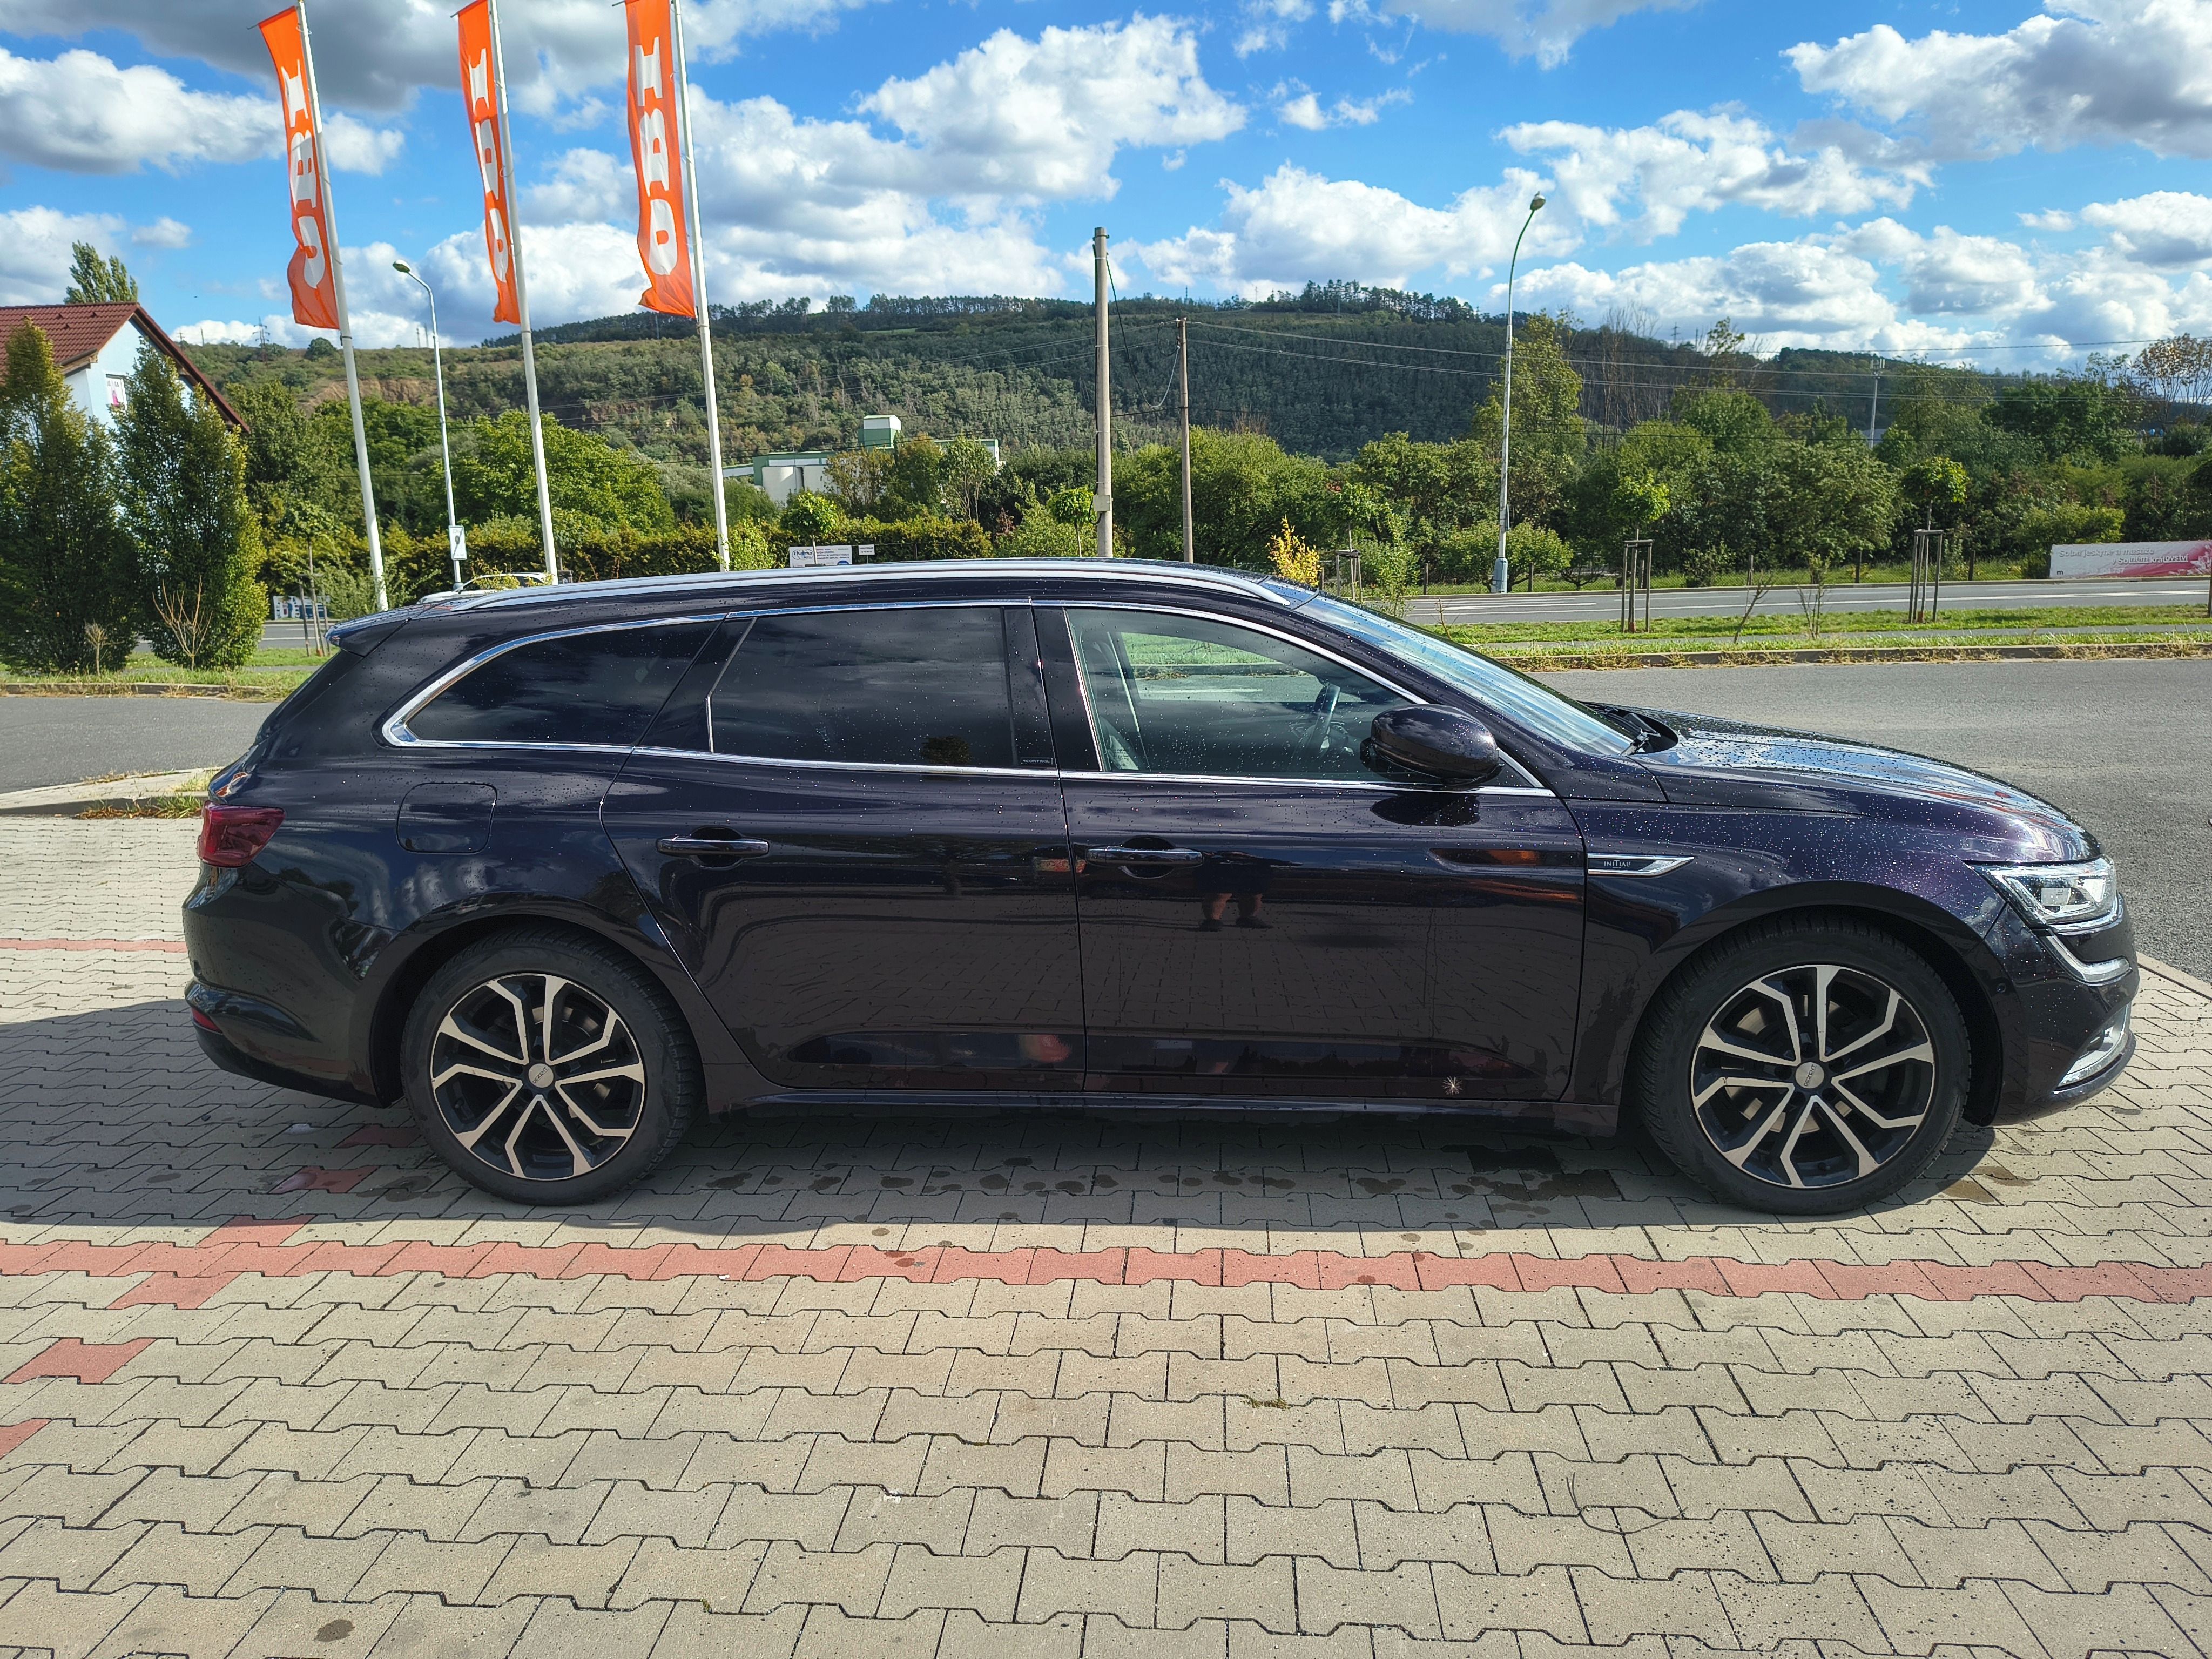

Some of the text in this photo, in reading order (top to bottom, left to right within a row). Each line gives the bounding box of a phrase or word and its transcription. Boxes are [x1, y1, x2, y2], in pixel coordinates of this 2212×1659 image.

[635, 37, 678, 275] OBI
[280, 59, 326, 289] OBI
[2152, 554, 2189, 563] království
[532, 1067, 549, 1084] DEZENT
[1803, 1064, 1816, 1087] DEZENT
